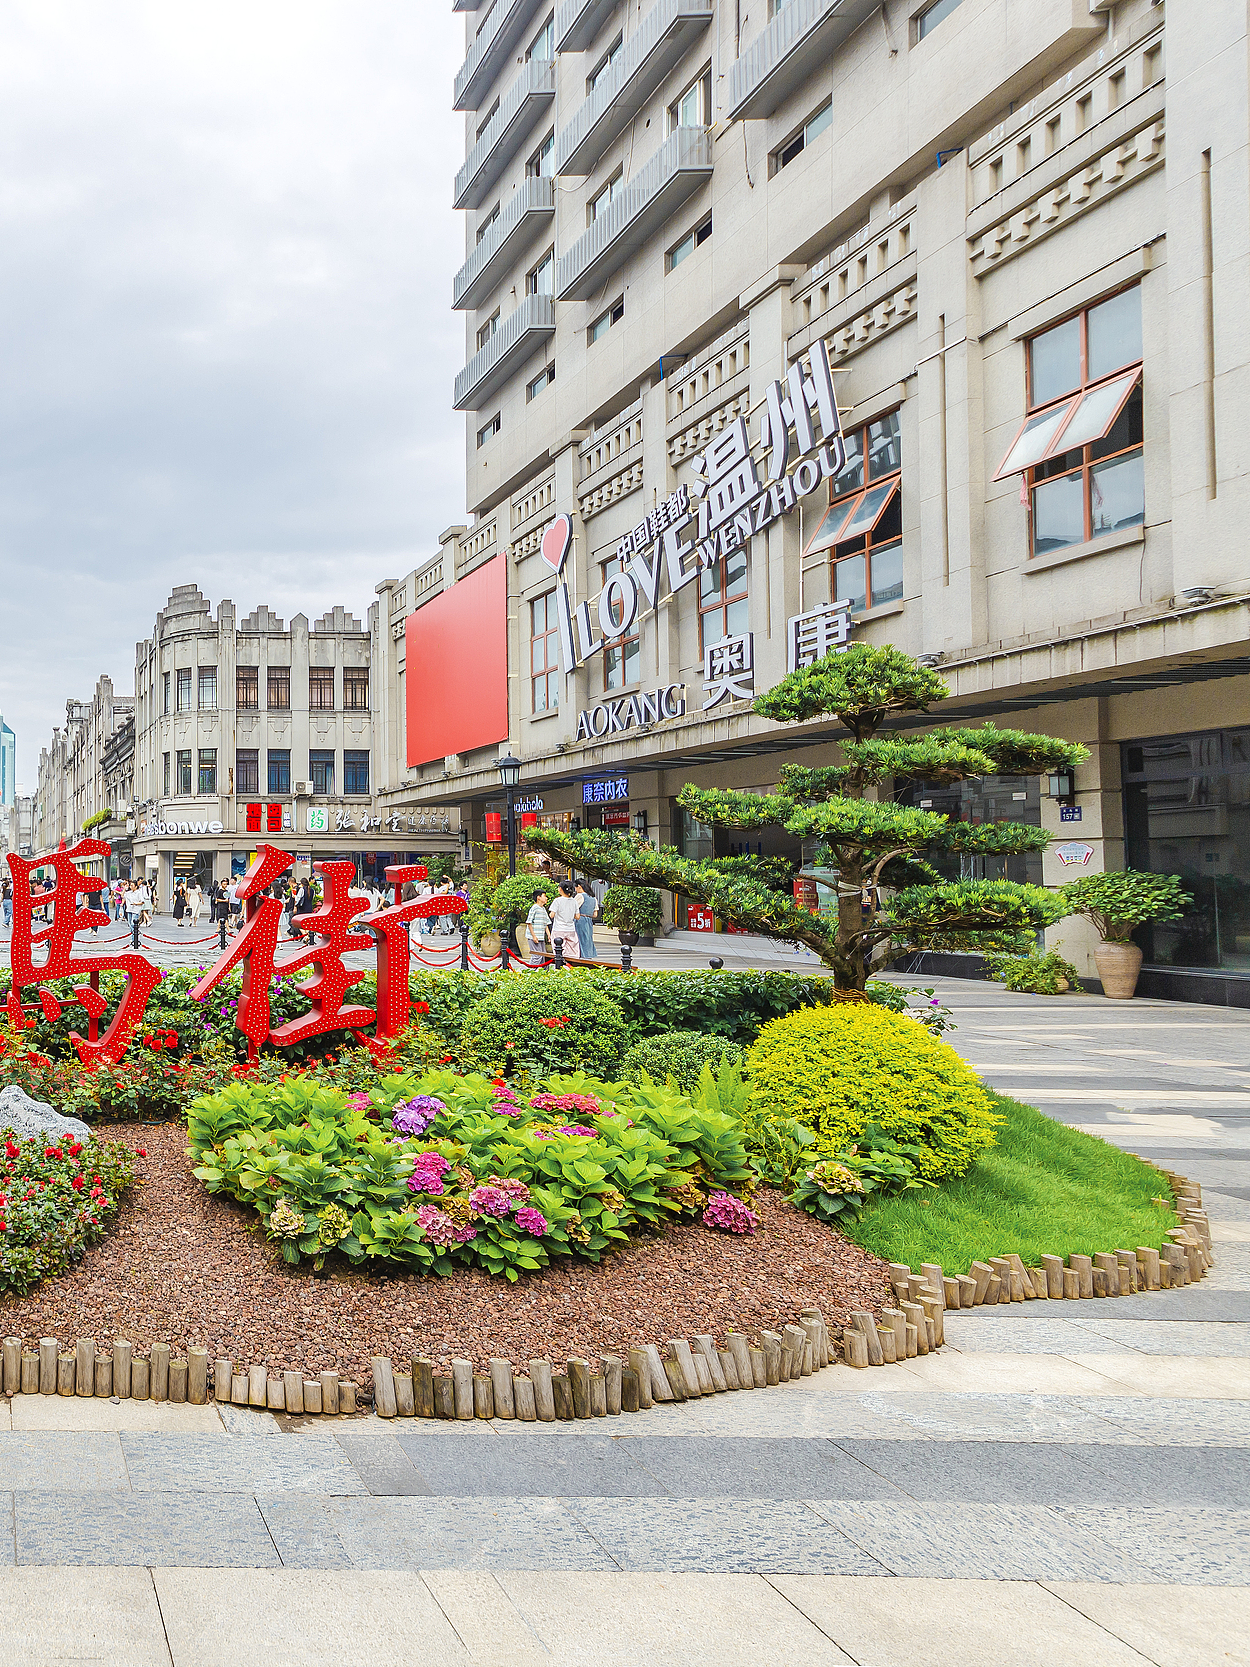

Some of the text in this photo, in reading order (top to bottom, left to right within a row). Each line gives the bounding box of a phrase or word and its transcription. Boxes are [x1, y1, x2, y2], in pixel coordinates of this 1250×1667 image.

[691, 339, 840, 539] 温州
[616, 483, 690, 564] 中国鞋都
[697, 436, 848, 571] WENZHOU
[576, 514, 701, 662] LOVE
[702, 598, 854, 711] 奥康
[575, 683, 686, 742] AOKANG
[310, 809, 324, 829] 药
[334, 808, 407, 833] 张和堂
[582, 778, 629, 803] 康奈内衣
